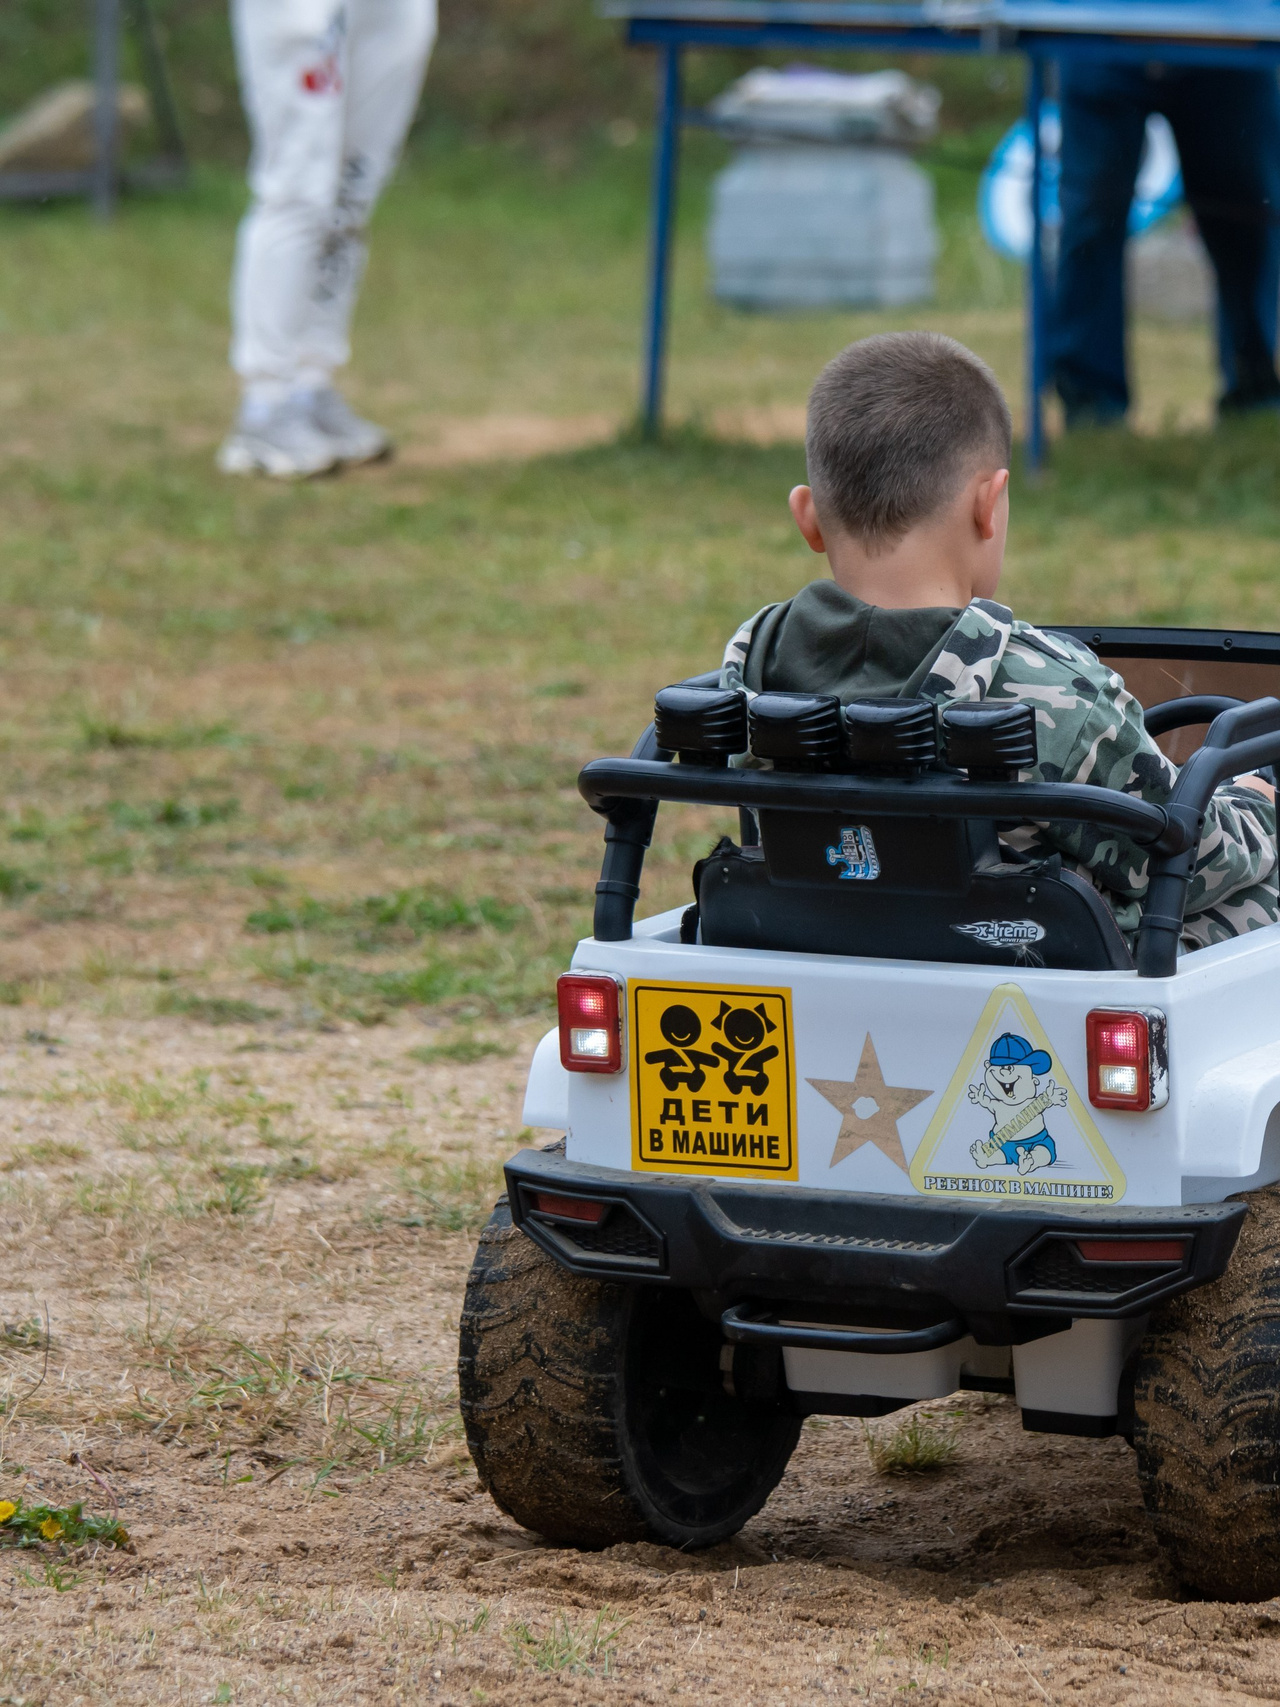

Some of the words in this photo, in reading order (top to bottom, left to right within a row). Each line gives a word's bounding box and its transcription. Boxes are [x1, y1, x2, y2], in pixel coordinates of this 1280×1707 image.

[979, 923, 1037, 937] x-treme
[660, 1097, 768, 1126] ДЕТИ
[981, 1091, 1052, 1158] ВНИМАНИЕ!
[649, 1128, 664, 1152] В
[672, 1129, 780, 1160] МАШИНЕ
[924, 1176, 1006, 1194] РЕБЕНОК
[1009, 1181, 1021, 1194] В
[1024, 1182, 1114, 1198] МАШИНЕ!
